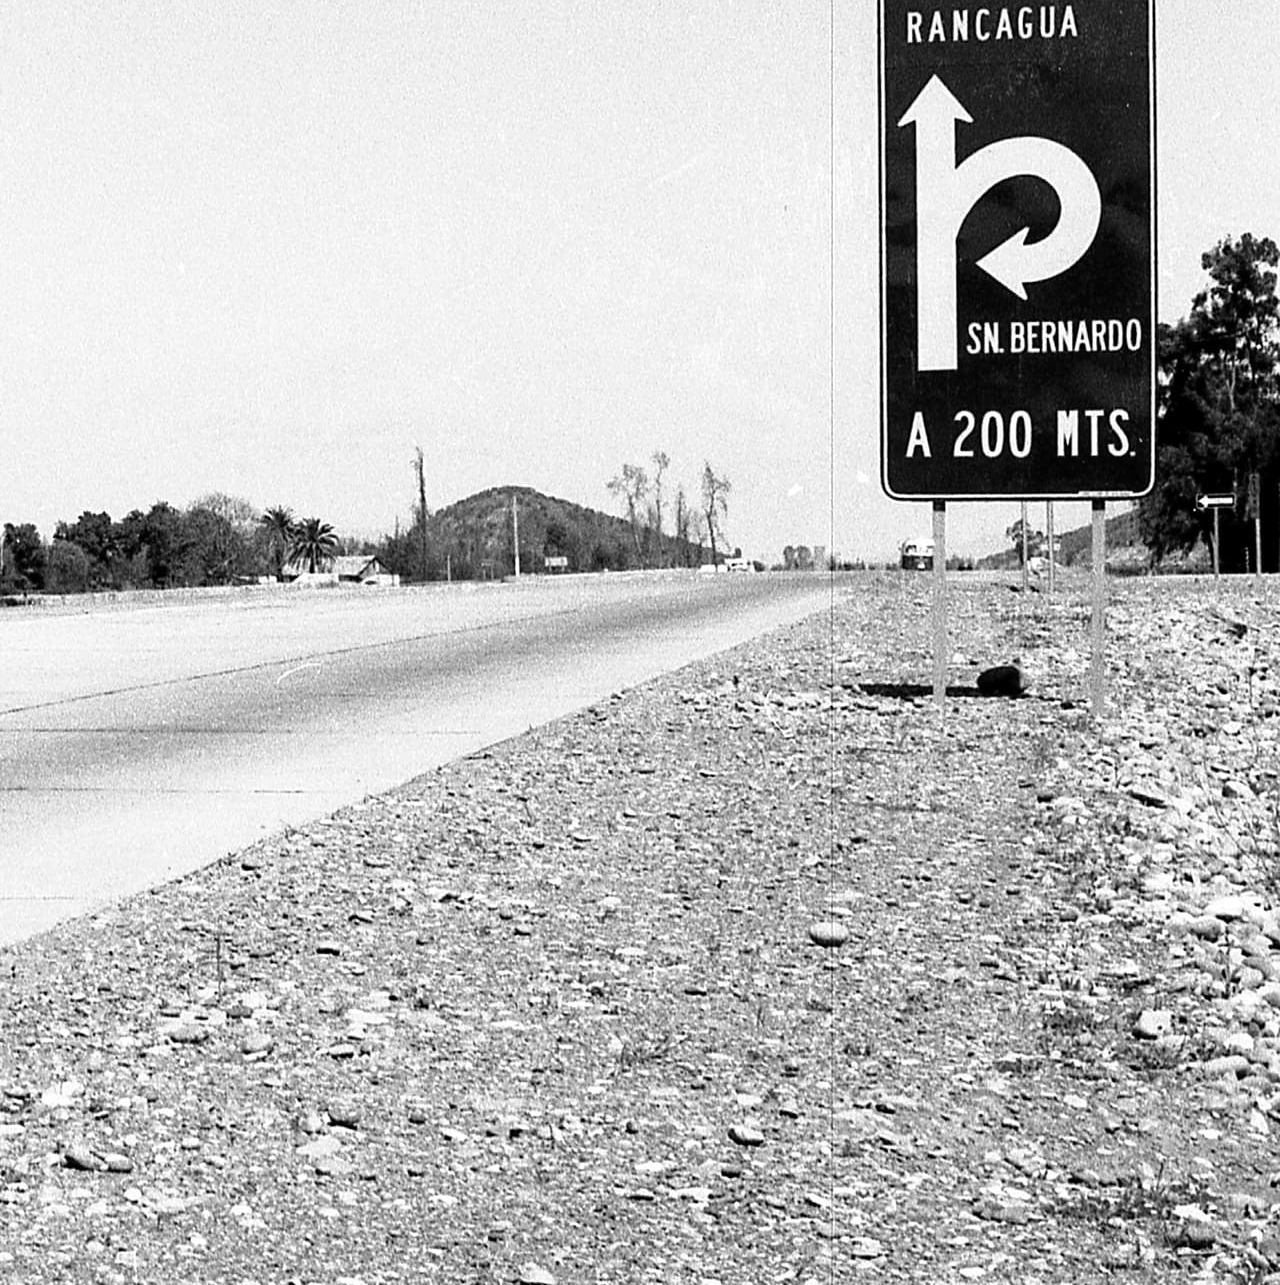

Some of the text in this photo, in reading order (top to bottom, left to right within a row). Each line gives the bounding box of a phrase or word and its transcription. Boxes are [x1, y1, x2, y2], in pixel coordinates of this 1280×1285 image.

[908, 6, 1078, 43] RANCAGUA
[967, 319, 1142, 354] SN. BERNARDO
[906, 409, 1137, 457] A 200 MTS.
